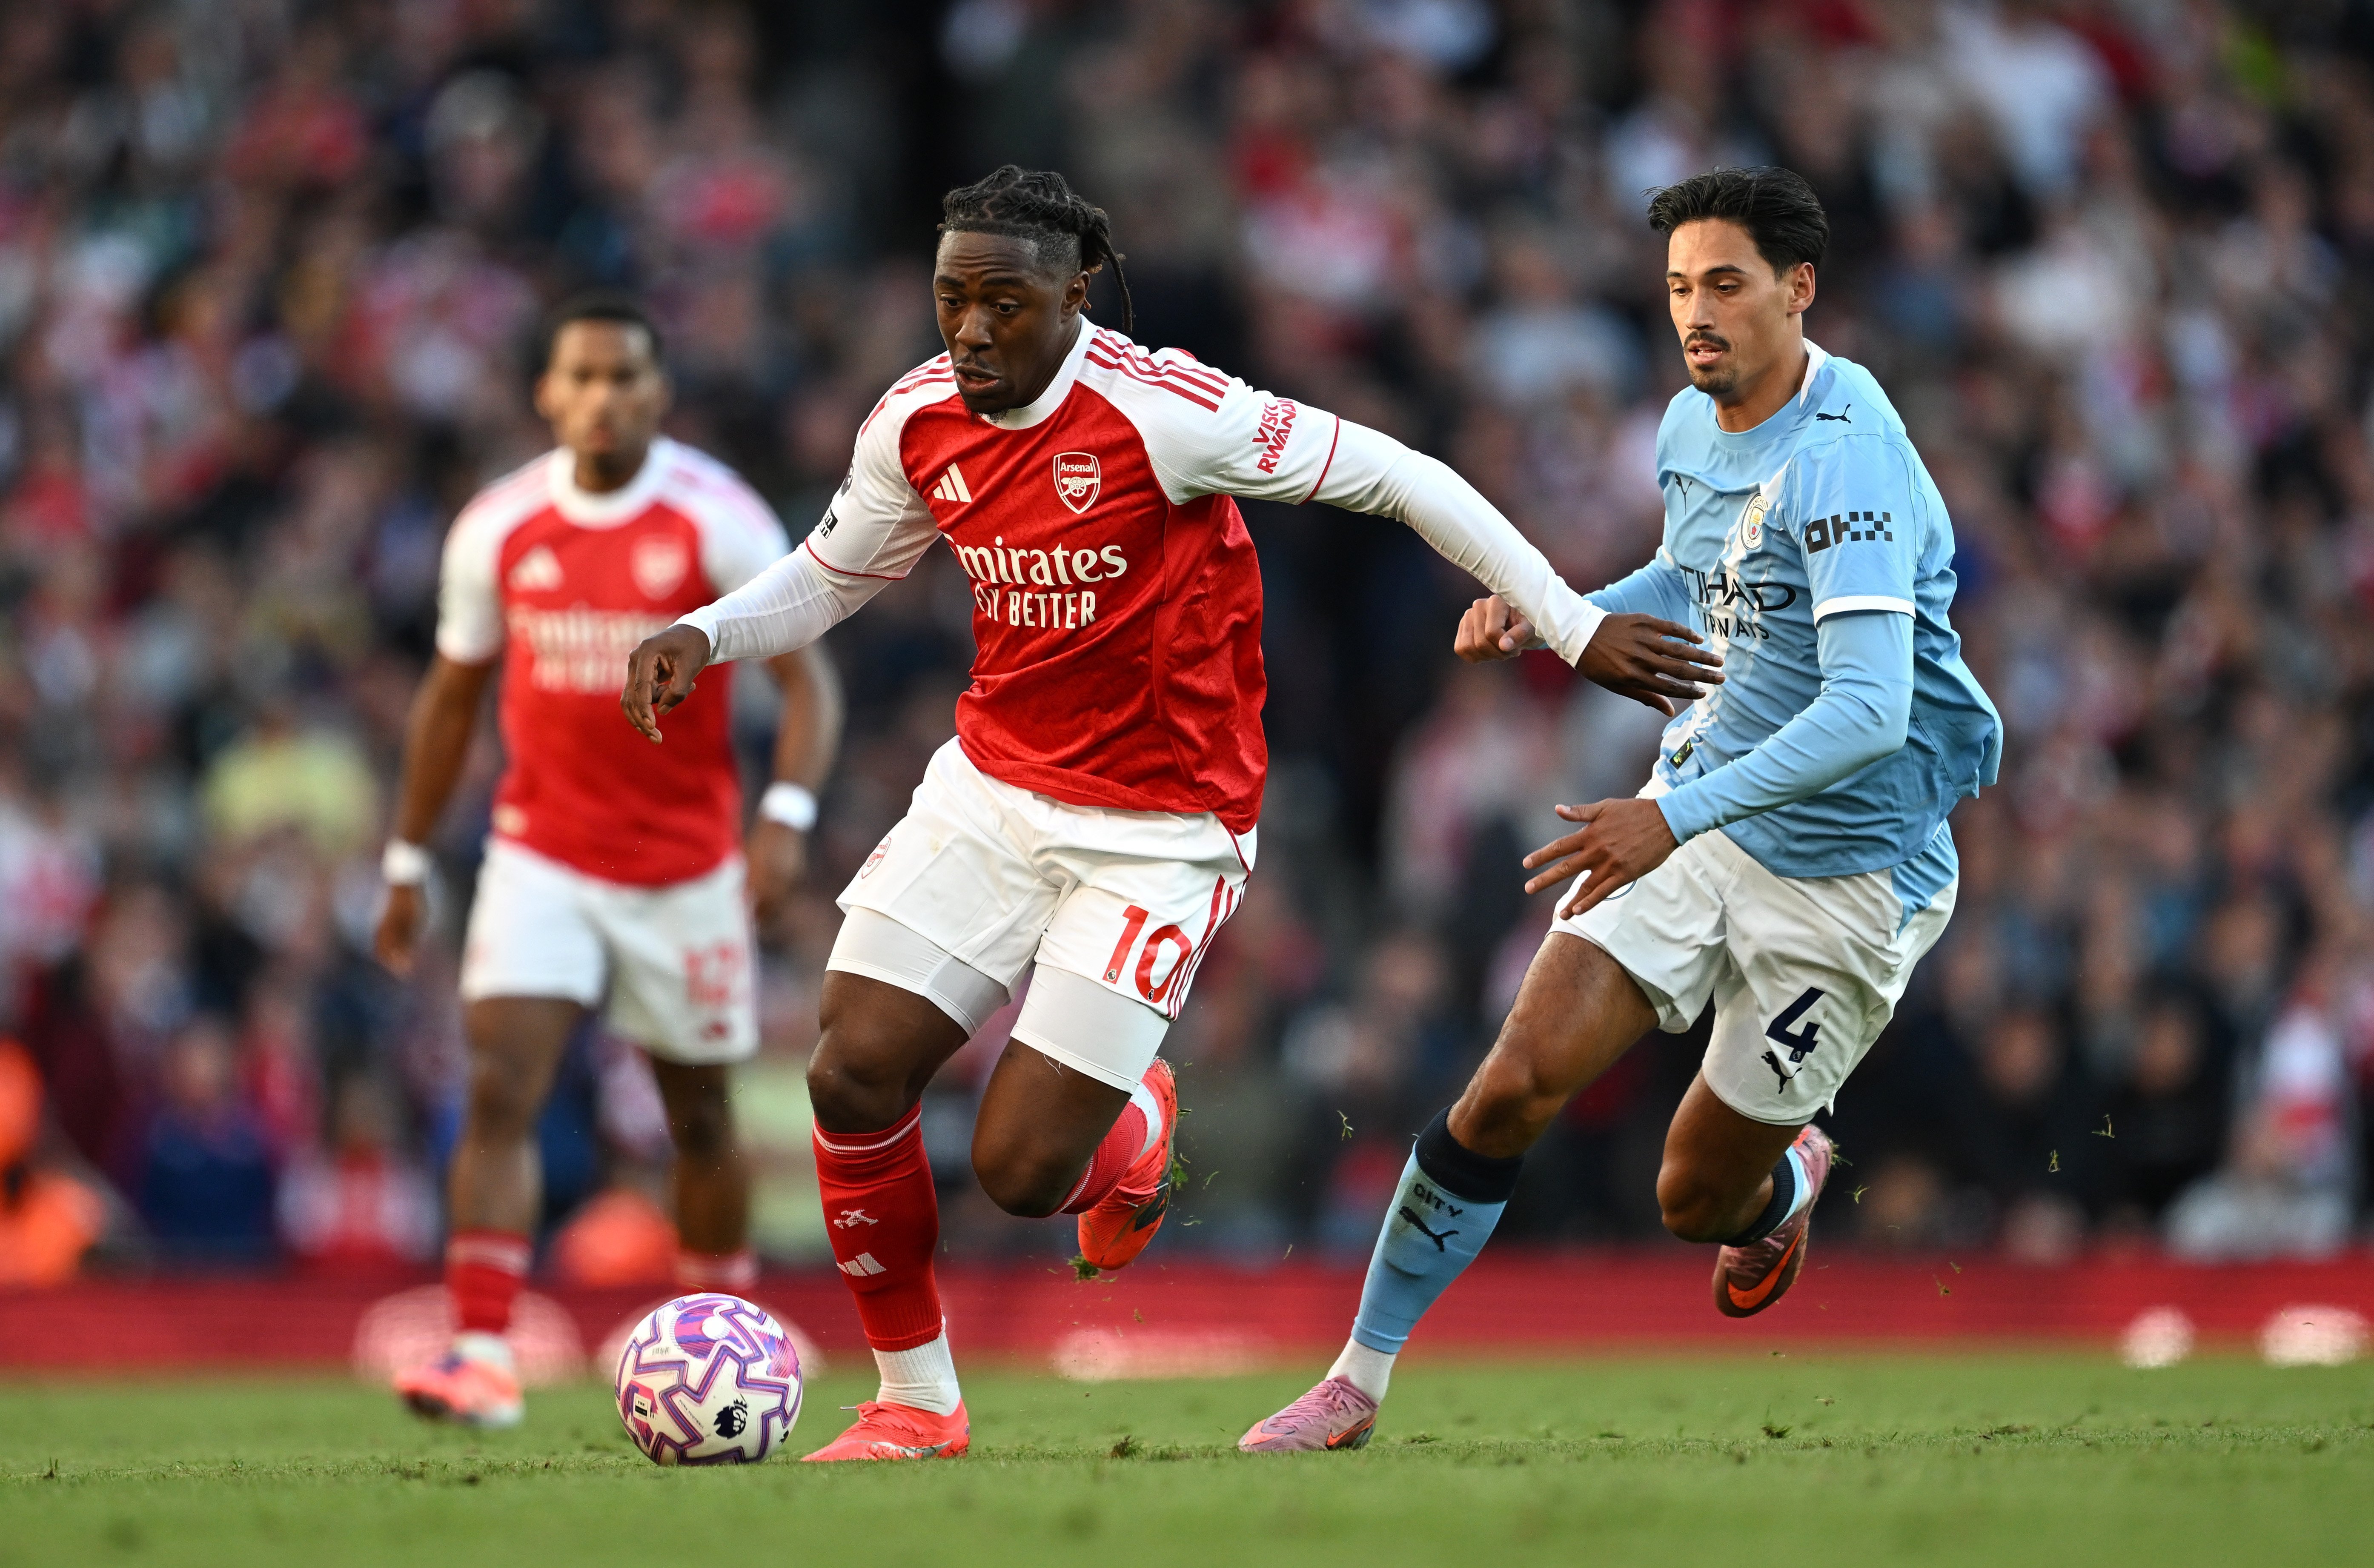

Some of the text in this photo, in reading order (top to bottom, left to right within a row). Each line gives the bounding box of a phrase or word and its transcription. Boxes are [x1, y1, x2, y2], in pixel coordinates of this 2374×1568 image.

[1060, 462, 1094, 472] Arsenal
[1805, 511, 1893, 555] OKX
[943, 533, 1127, 586] mirates
[1008, 591, 1096, 629] BETTER
[1679, 564, 1796, 612] TIHAD
[1102, 904, 1192, 1004] 10
[1765, 987, 1826, 1064] 4
[1414, 1183, 1463, 1217] CITY
